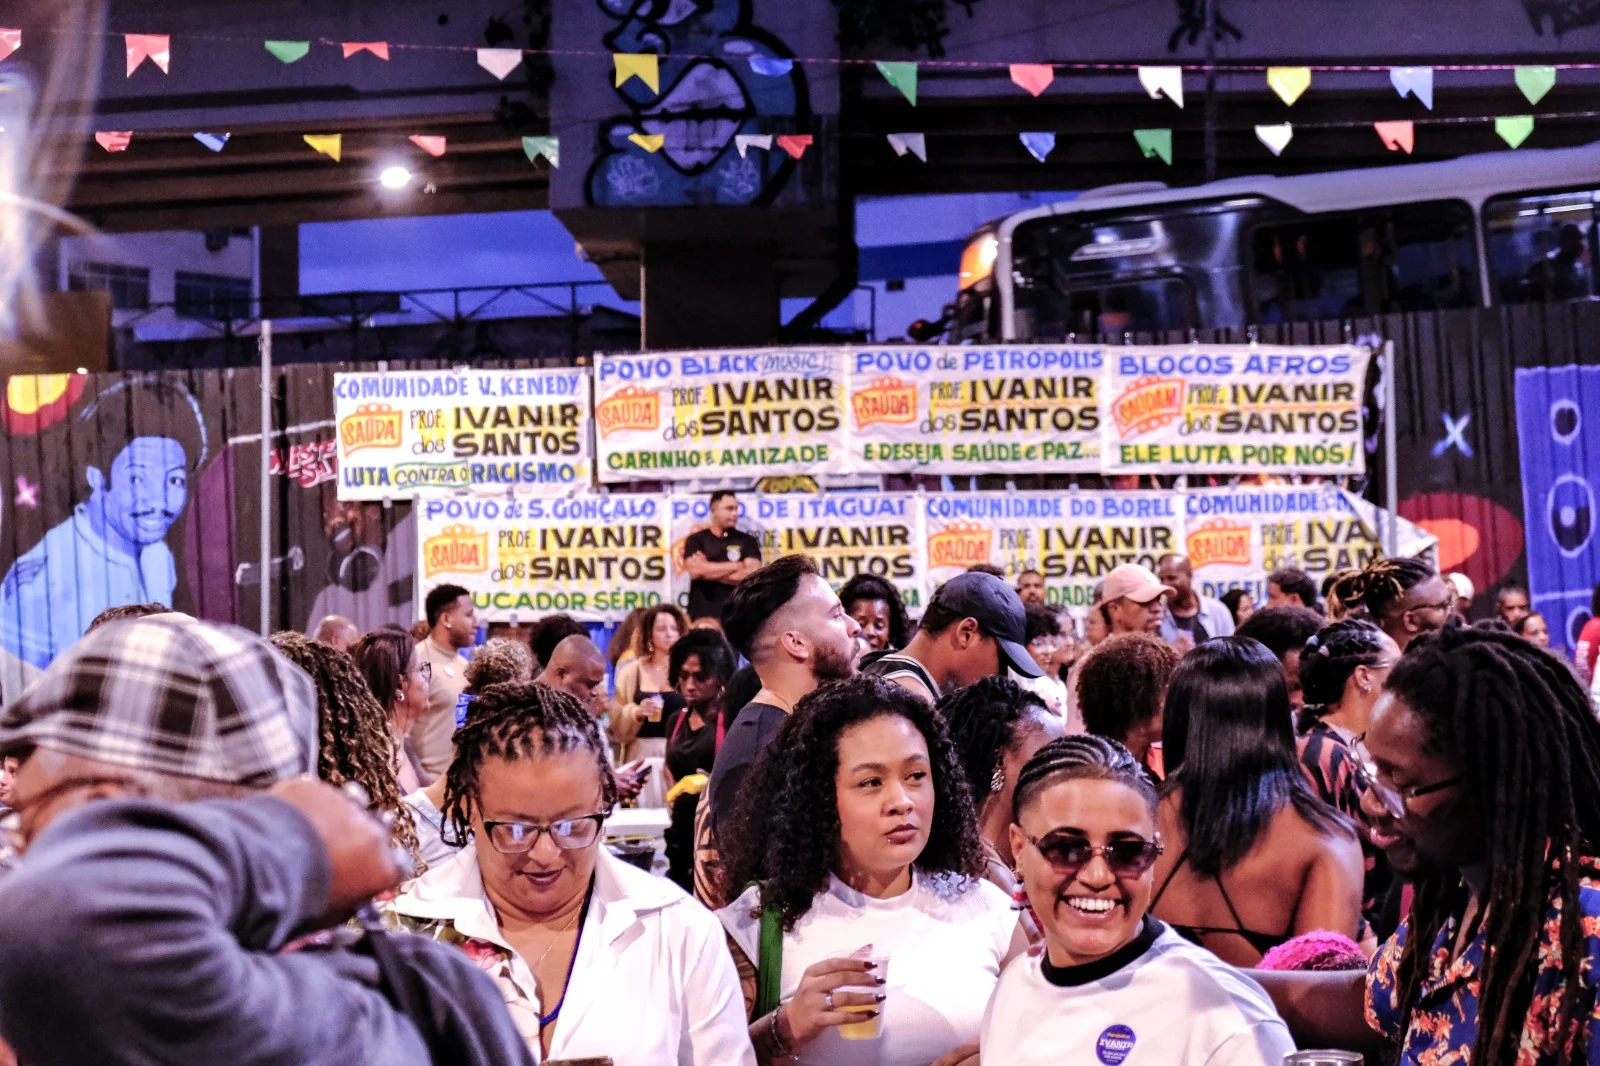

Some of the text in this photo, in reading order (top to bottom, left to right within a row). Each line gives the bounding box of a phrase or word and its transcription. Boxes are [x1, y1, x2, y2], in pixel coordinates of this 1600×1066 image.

[599, 358, 672, 380] POVO
[681, 355, 758, 376] BLACK
[856, 351, 1104, 373] POVO de PETROPOLIS
[1119, 354, 1351, 375] BLOCOS AFROS
[336, 375, 579, 399] COMUNIDADE V. KENEDY
[671, 378, 833, 407] PROF. IVANIR
[929, 377, 1093, 402] PROF. IVANIR
[1231, 383, 1354, 404] IVANIR
[410, 404, 579, 430] PROF. IVANIR
[662, 406, 840, 442] dos SANTOS
[919, 406, 1100, 435] dos SANTOS
[1177, 411, 1359, 437] dos SANTOS
[411, 431, 581, 458] dos SANTOS
[864, 442, 874, 461] E
[879, 442, 943, 464] DESEJA
[952, 440, 1021, 462] SAÚDE
[1119, 444, 1162, 464] ELE
[1171, 444, 1234, 465] LUTA
[1242, 443, 1287, 465] POR
[607, 451, 701, 470] CARINHO
[719, 445, 829, 466] AMIZADE
[343, 466, 391, 488] LUTA
[394, 467, 457, 487] CONTRA
[470, 462, 575, 484] RACISMO
[427, 499, 656, 523] POVO de S. GONÇALO
[672, 500, 746, 519] POO
[757, 500, 788, 519] DE
[927, 498, 1175, 518] COMUNIDADE DO BOREL
[1186, 492, 1320, 515] COMUNIDADE
[498, 525, 662, 552] PROF. IVANIR
[786, 524, 910, 549] IVANIR
[998, 525, 1173, 550] PROF. IVANIR
[1307, 521, 1373, 545] IVA
[491, 555, 666, 583] dos SANTOS
[822, 555, 915, 579] NTOS
[1043, 553, 1159, 578] SANTO
[473, 591, 585, 611] UCADOR
[594, 587, 662, 611] SÉRIO
